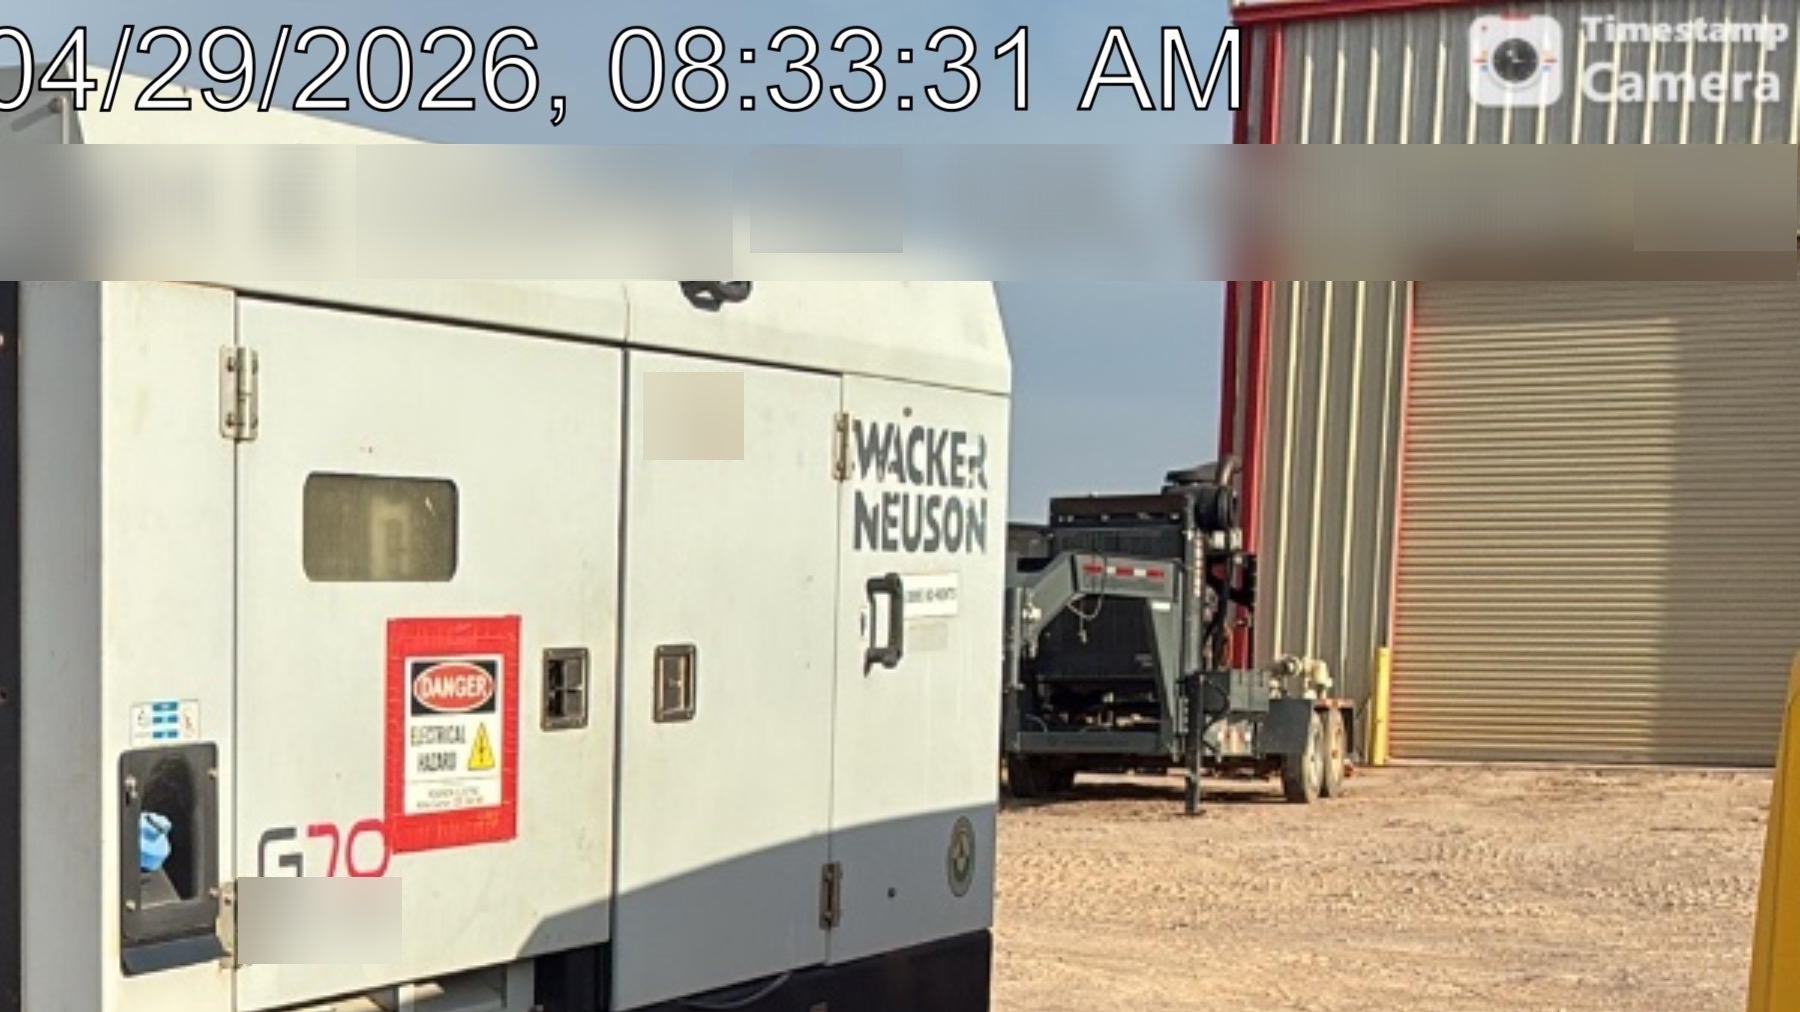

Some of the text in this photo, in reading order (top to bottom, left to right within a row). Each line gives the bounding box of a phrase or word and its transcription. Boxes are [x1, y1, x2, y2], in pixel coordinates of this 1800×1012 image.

[853, 419, 988, 490] WACKER
[854, 490, 987, 554] NEUSON
[420, 674, 488, 698] DANGER
[410, 725, 466, 746] ELECTRICAL
[417, 751, 457, 772] HAZARD
[258, 818, 390, 878] G70
